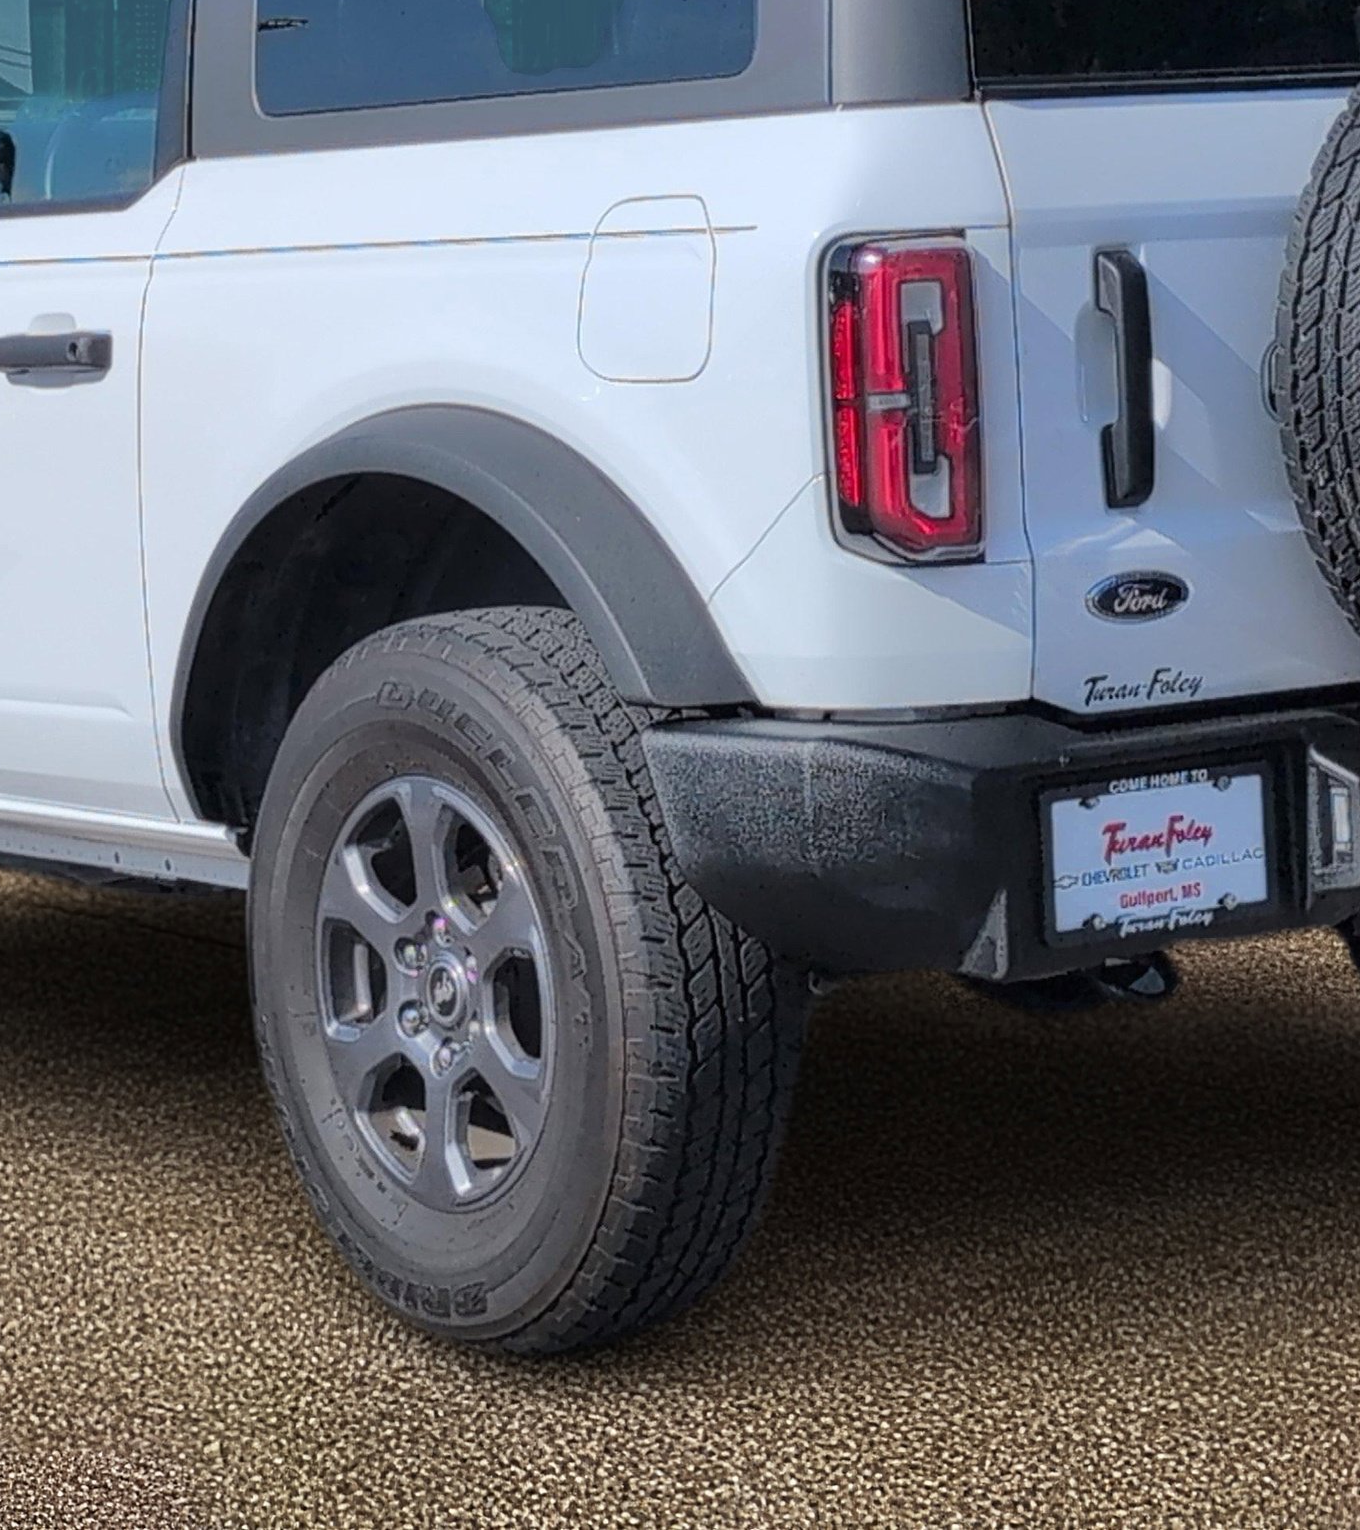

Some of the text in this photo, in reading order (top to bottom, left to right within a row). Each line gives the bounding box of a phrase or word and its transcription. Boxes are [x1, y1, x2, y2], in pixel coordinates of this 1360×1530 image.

[1113, 582, 1169, 613] Ford
[1109, 768, 1208, 794] COME HOME TO
[1081, 847, 1265, 887] CHEVROLET CADILLAC
[1182, 882, 1201, 898] MS
